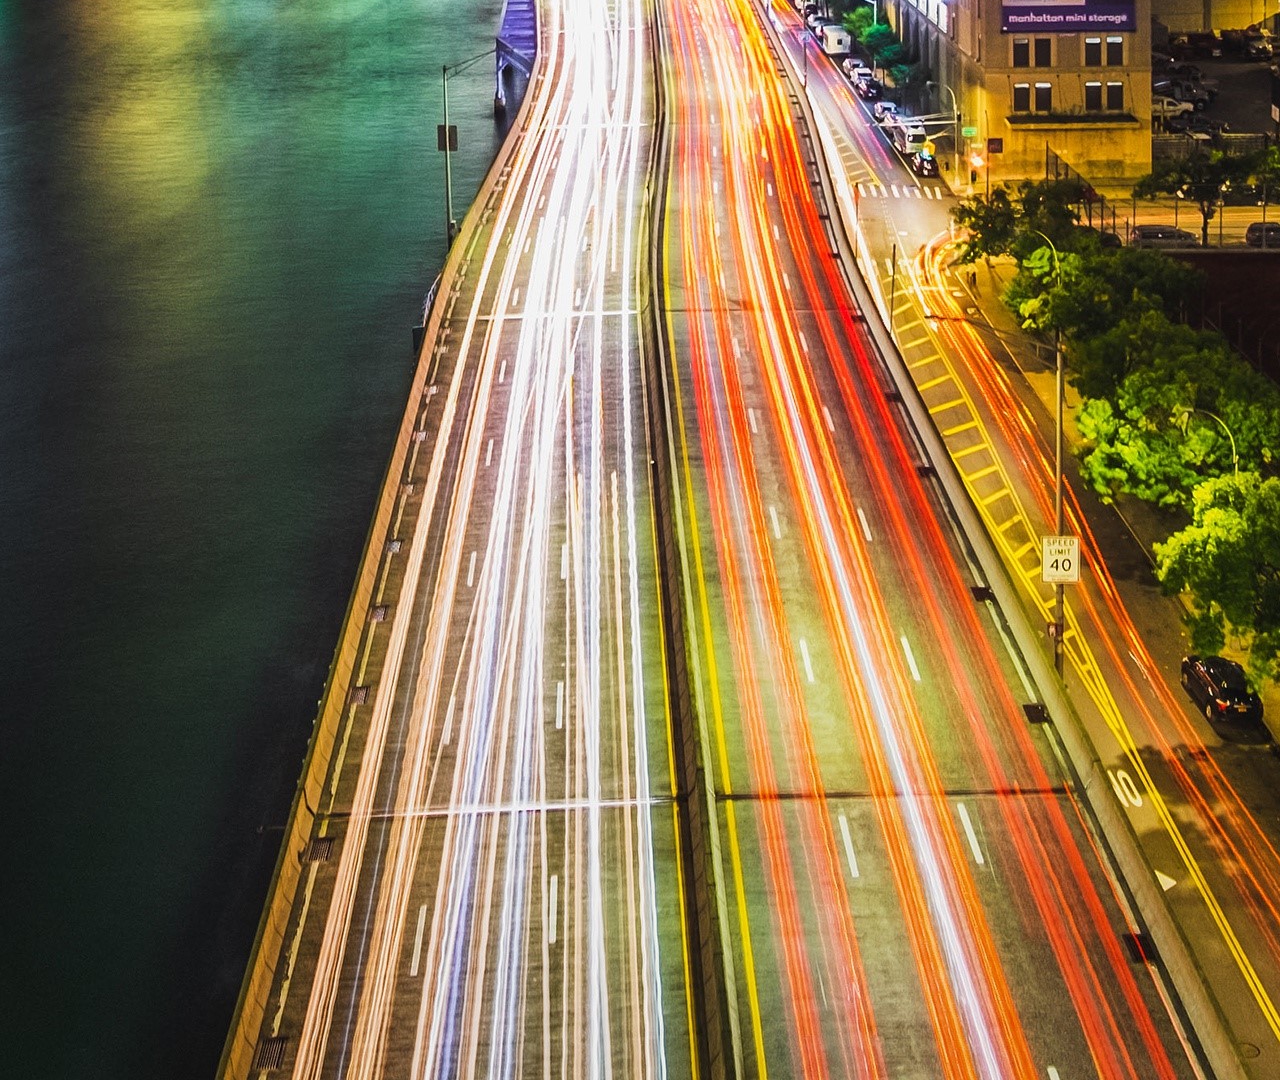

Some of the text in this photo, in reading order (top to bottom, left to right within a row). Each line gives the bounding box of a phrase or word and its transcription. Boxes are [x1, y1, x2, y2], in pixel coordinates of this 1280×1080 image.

[1008, 11, 1127, 24] manhattan mini storage
[1050, 559, 1071, 571] 40
